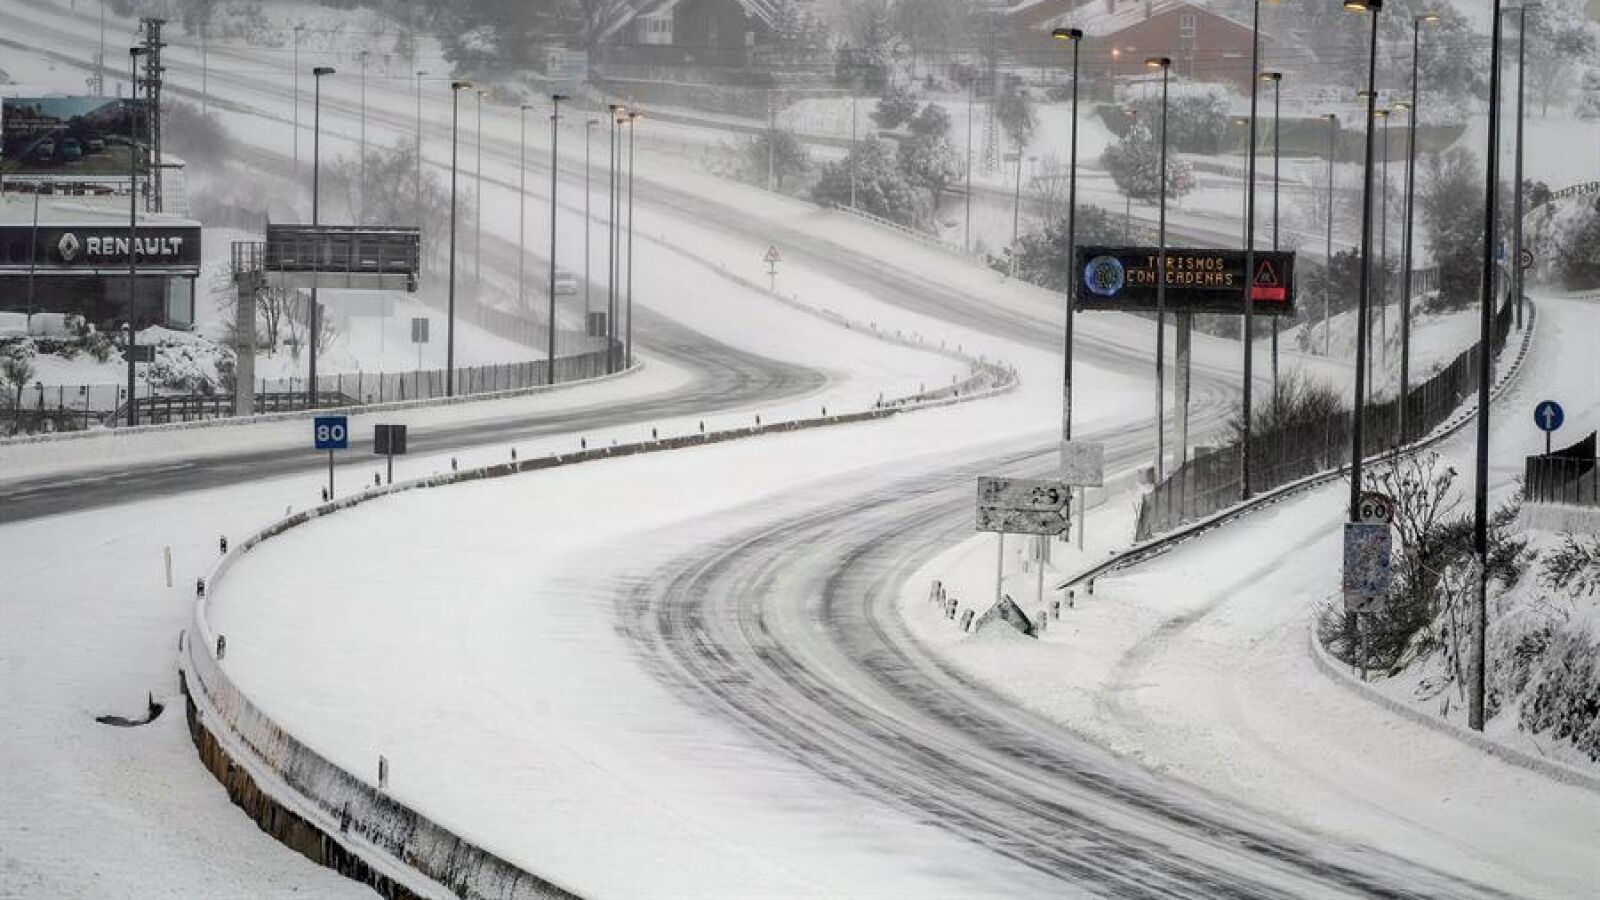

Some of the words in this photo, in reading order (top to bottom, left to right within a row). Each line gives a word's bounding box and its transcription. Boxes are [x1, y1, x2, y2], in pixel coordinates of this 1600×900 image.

[86, 236, 183, 255] RENAULT
[1126, 269, 1155, 283] CON
[1166, 271, 1233, 285] CADENAS
[318, 424, 344, 441] 80
[1363, 504, 1386, 519] 60
